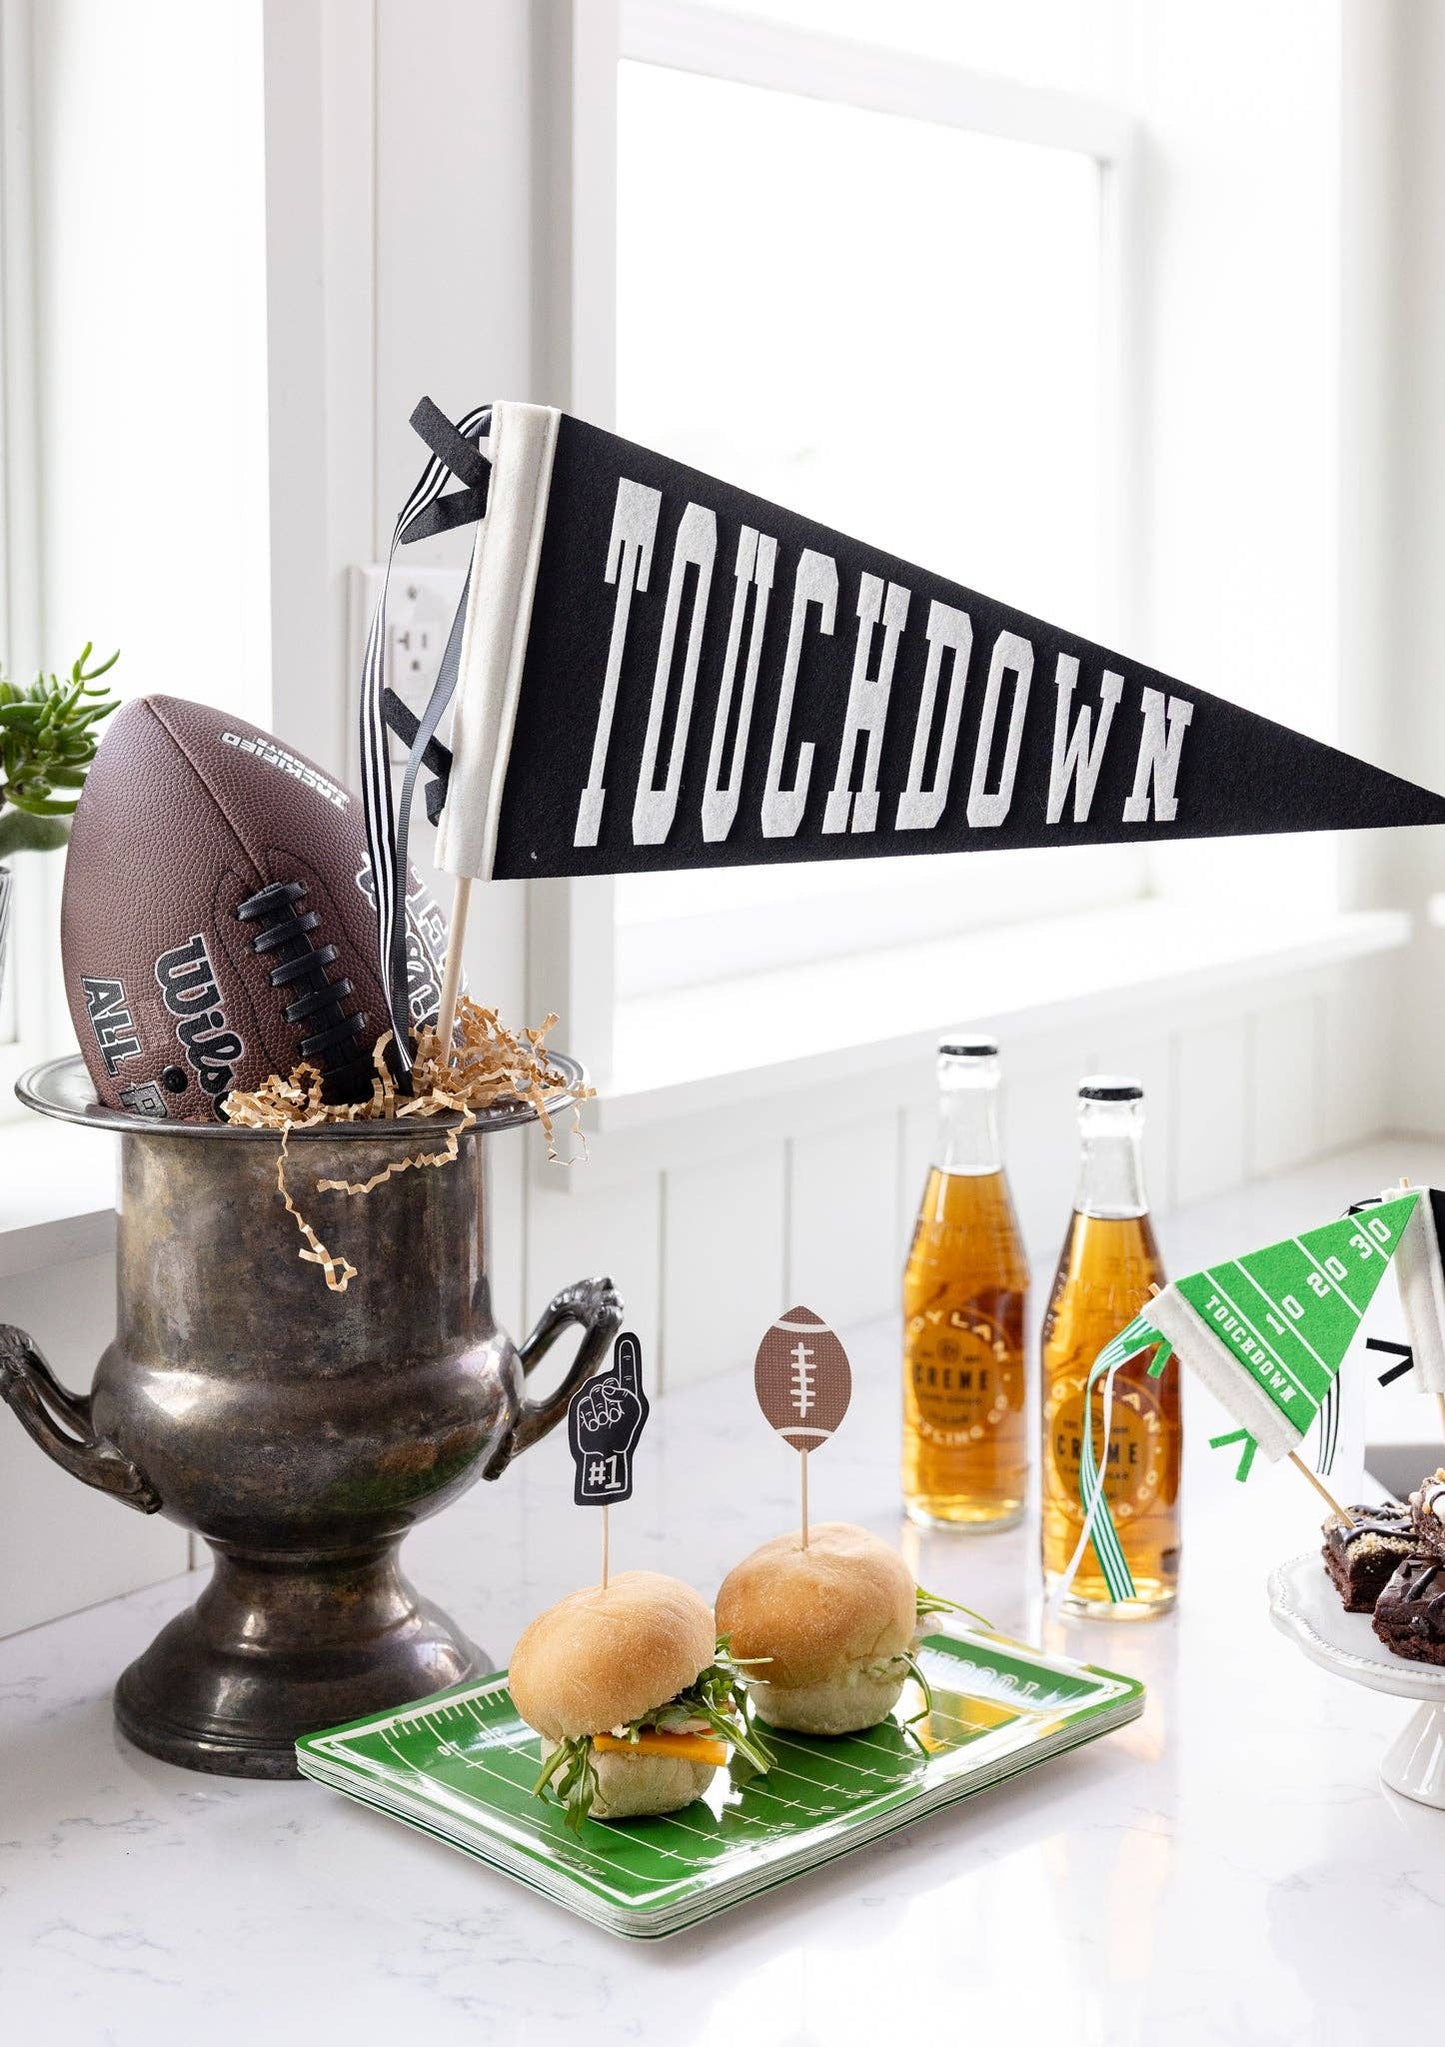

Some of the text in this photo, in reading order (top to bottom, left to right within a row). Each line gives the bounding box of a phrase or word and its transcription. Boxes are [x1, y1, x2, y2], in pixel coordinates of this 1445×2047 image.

[573, 476, 1195, 848] TOUCHDOWN
[220, 731, 348, 811] TACKIFIED
[81, 976, 143, 1077] ALL
[1204, 1294, 1297, 1403] TOUCHDOWN
[588, 1455, 621, 1489] #1
